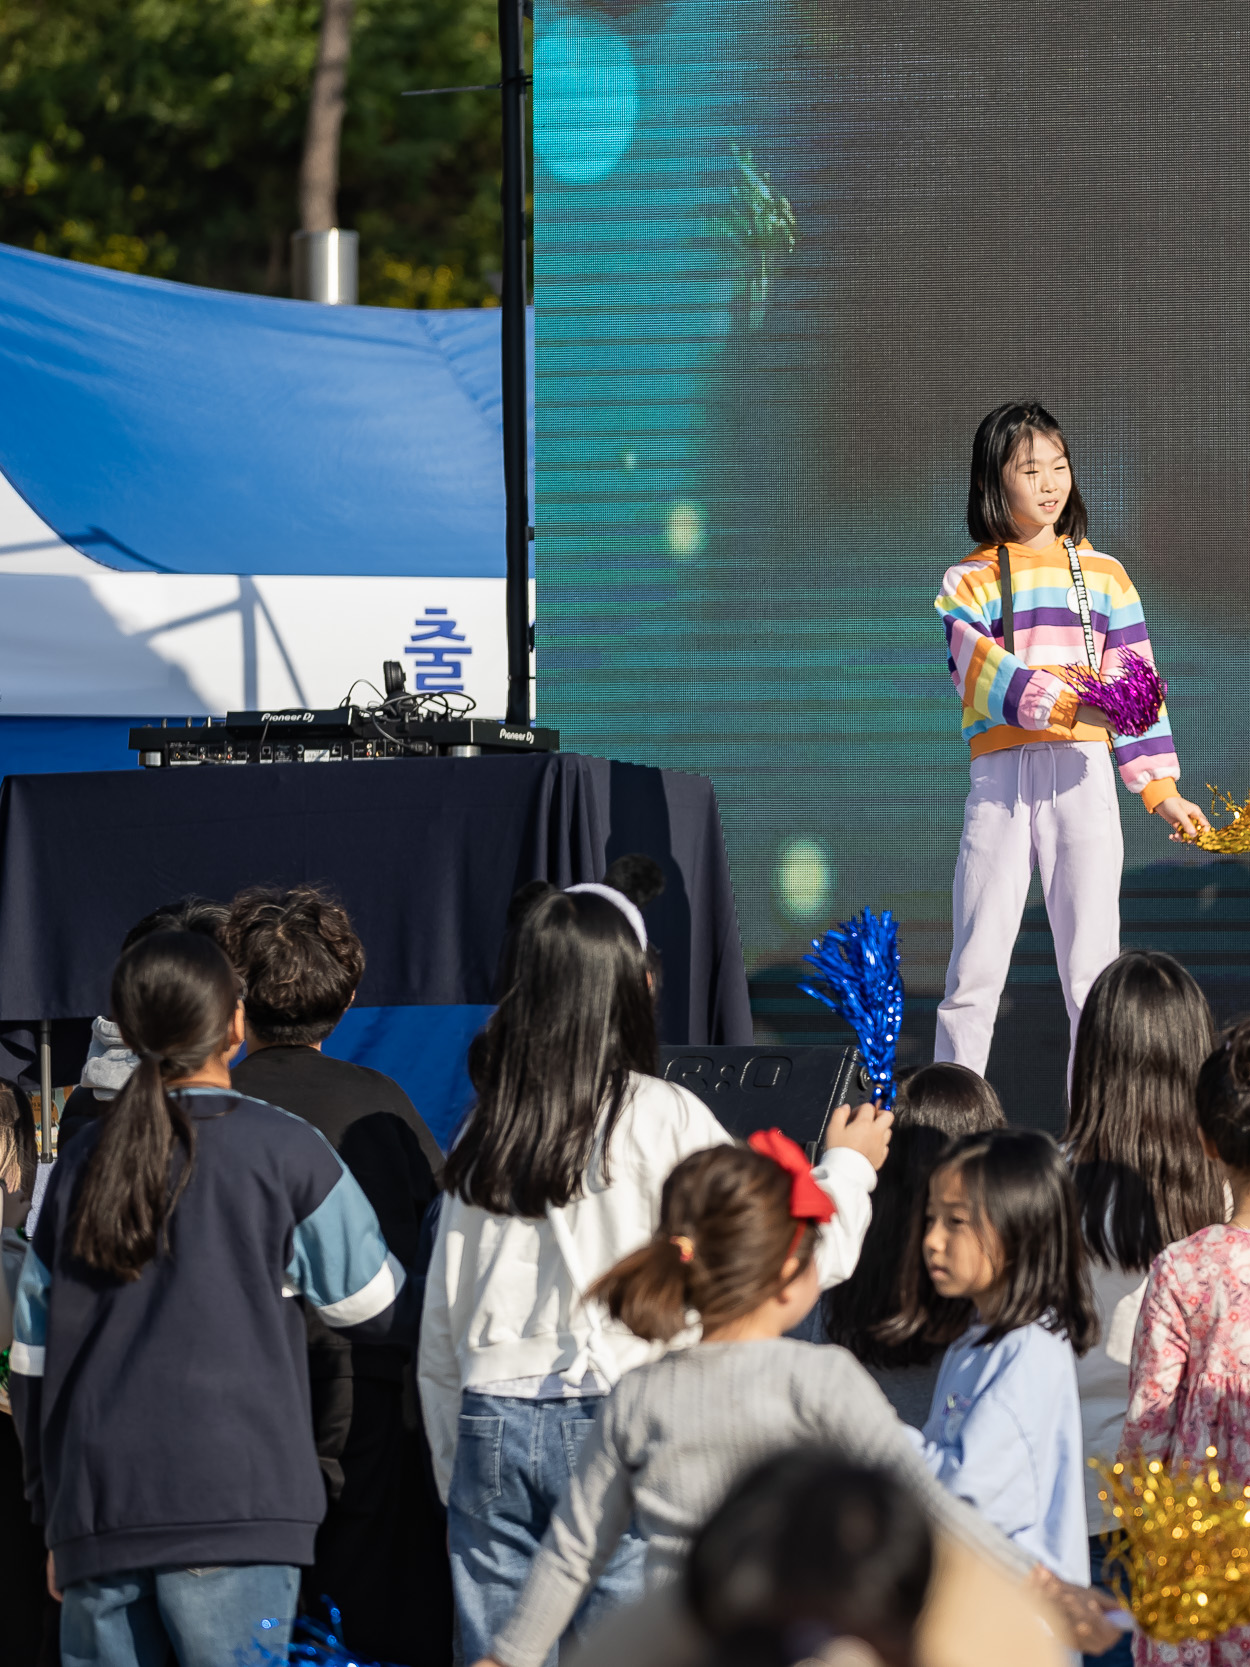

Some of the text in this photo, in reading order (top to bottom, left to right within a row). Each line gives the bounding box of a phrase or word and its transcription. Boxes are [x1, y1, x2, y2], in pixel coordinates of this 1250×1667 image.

[404, 607, 473, 691] 출
[261, 712, 300, 722] Pioneer
[499, 728, 527, 741] Pioneer
